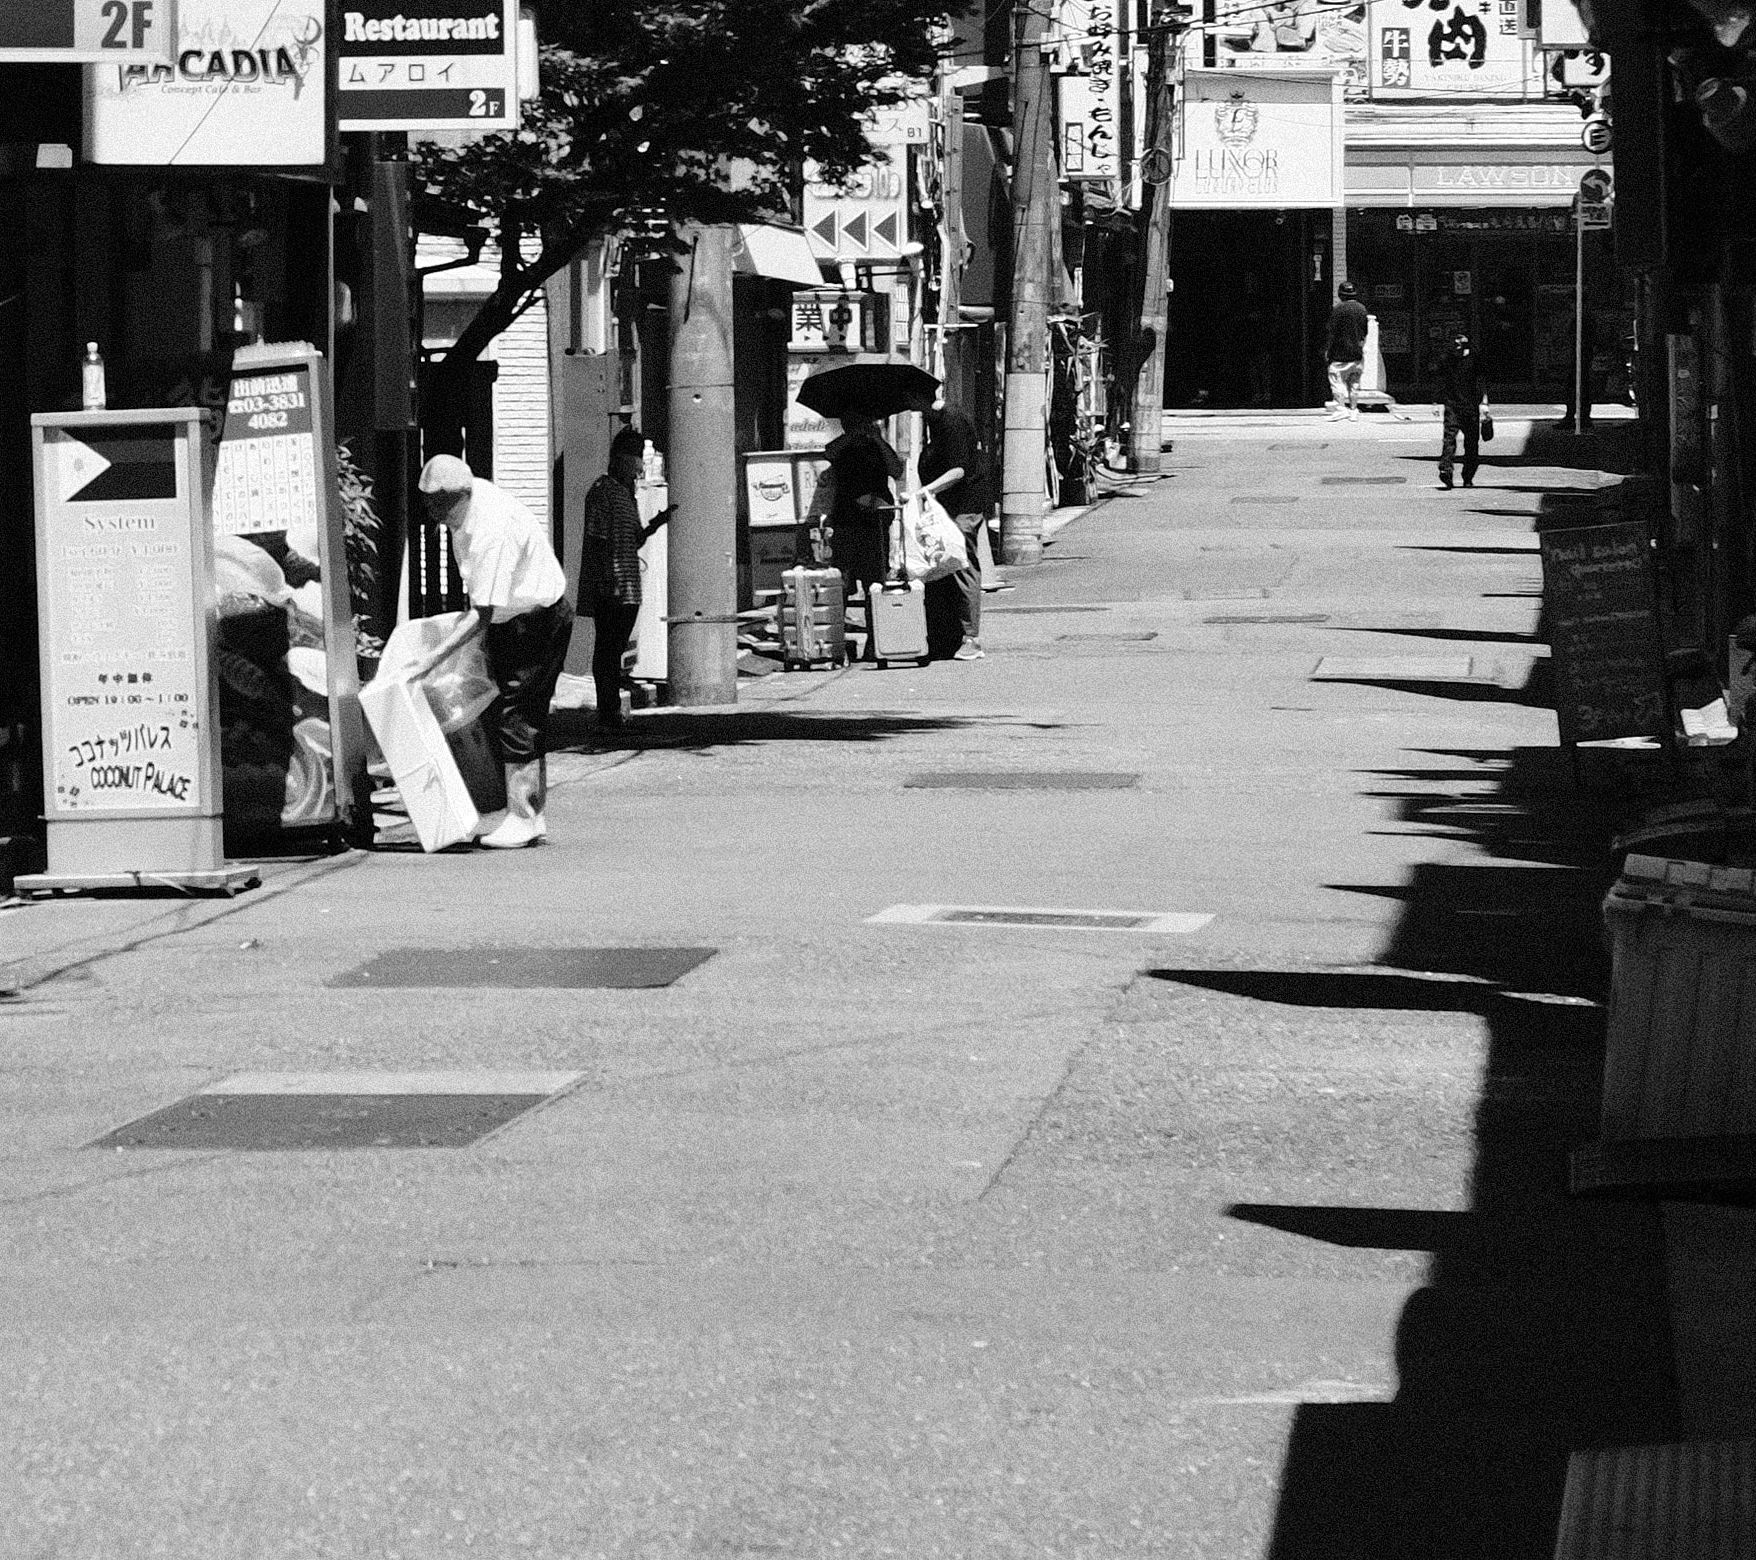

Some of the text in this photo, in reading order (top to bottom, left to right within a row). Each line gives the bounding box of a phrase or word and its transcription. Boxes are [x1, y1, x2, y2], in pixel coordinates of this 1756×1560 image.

[101, 0, 153, 49] 2F
[344, 11, 500, 41] Restaurant
[1436, 167, 1575, 187] LAWSON
[248, 410, 289, 429] 4082
[84, 516, 155, 534] System
